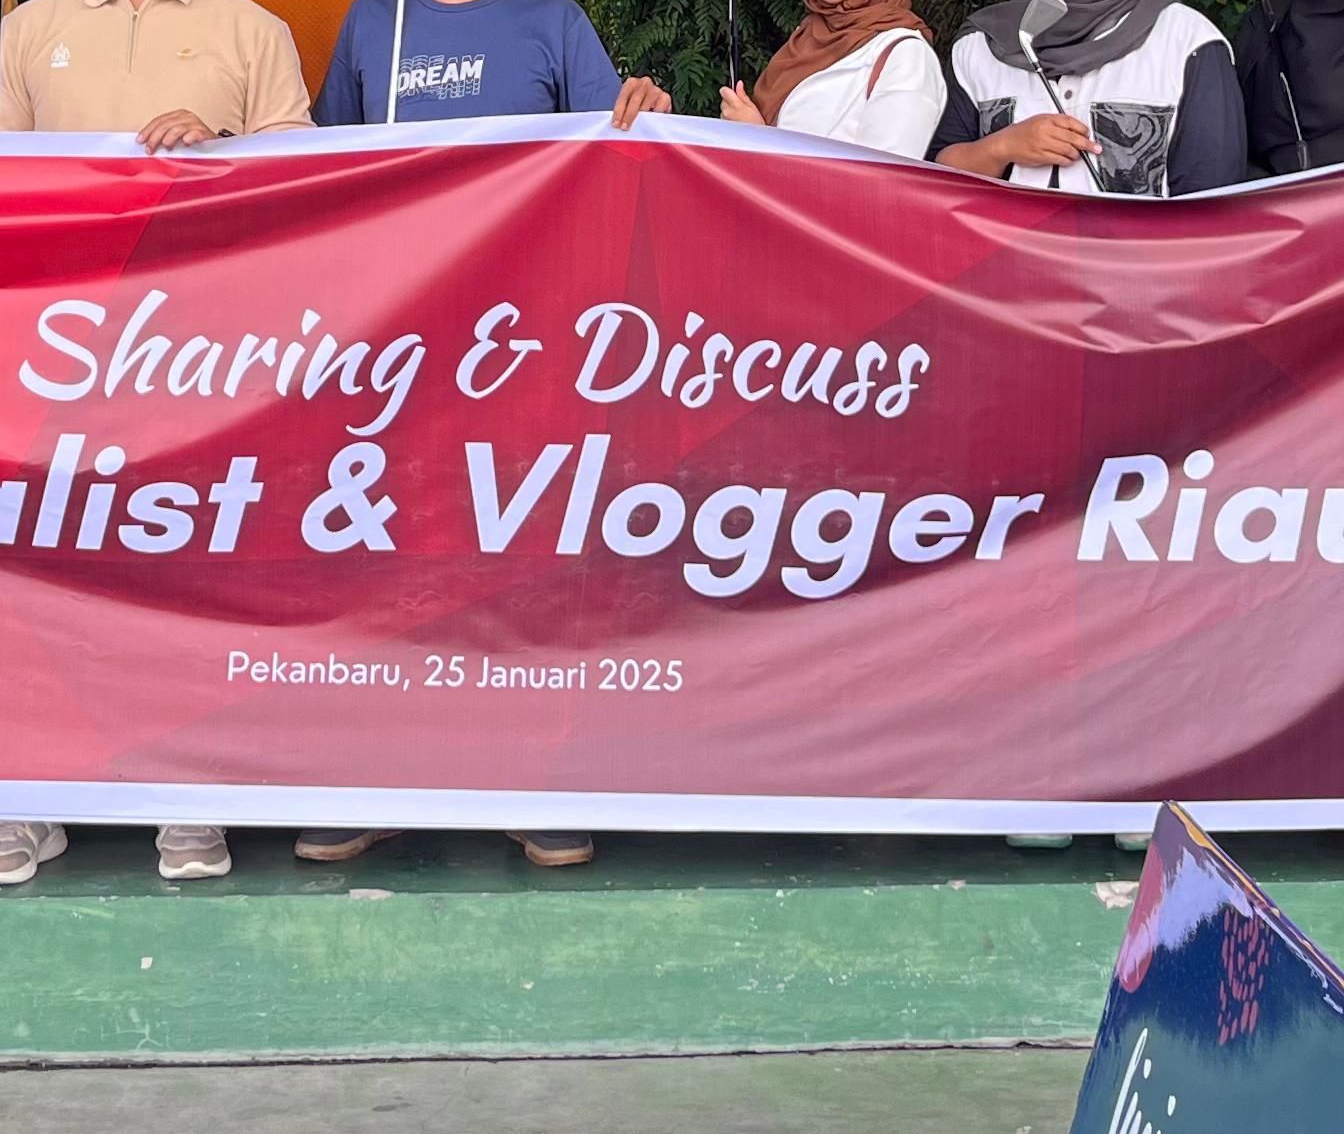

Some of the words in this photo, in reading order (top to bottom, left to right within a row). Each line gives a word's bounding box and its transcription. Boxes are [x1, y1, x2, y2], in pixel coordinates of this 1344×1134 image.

[397, 58, 484, 94] DREAM
[18, 289, 427, 436] Sharing
[455, 301, 543, 400] &
[574, 302, 931, 418] Discuss
[301, 441, 398, 553] &
[464, 433, 1044, 599] Vlogger
[227, 650, 411, 692] Pekanbaru,
[423, 654, 466, 688] 25
[476, 656, 587, 690] Januari
[597, 658, 685, 692] 2025
